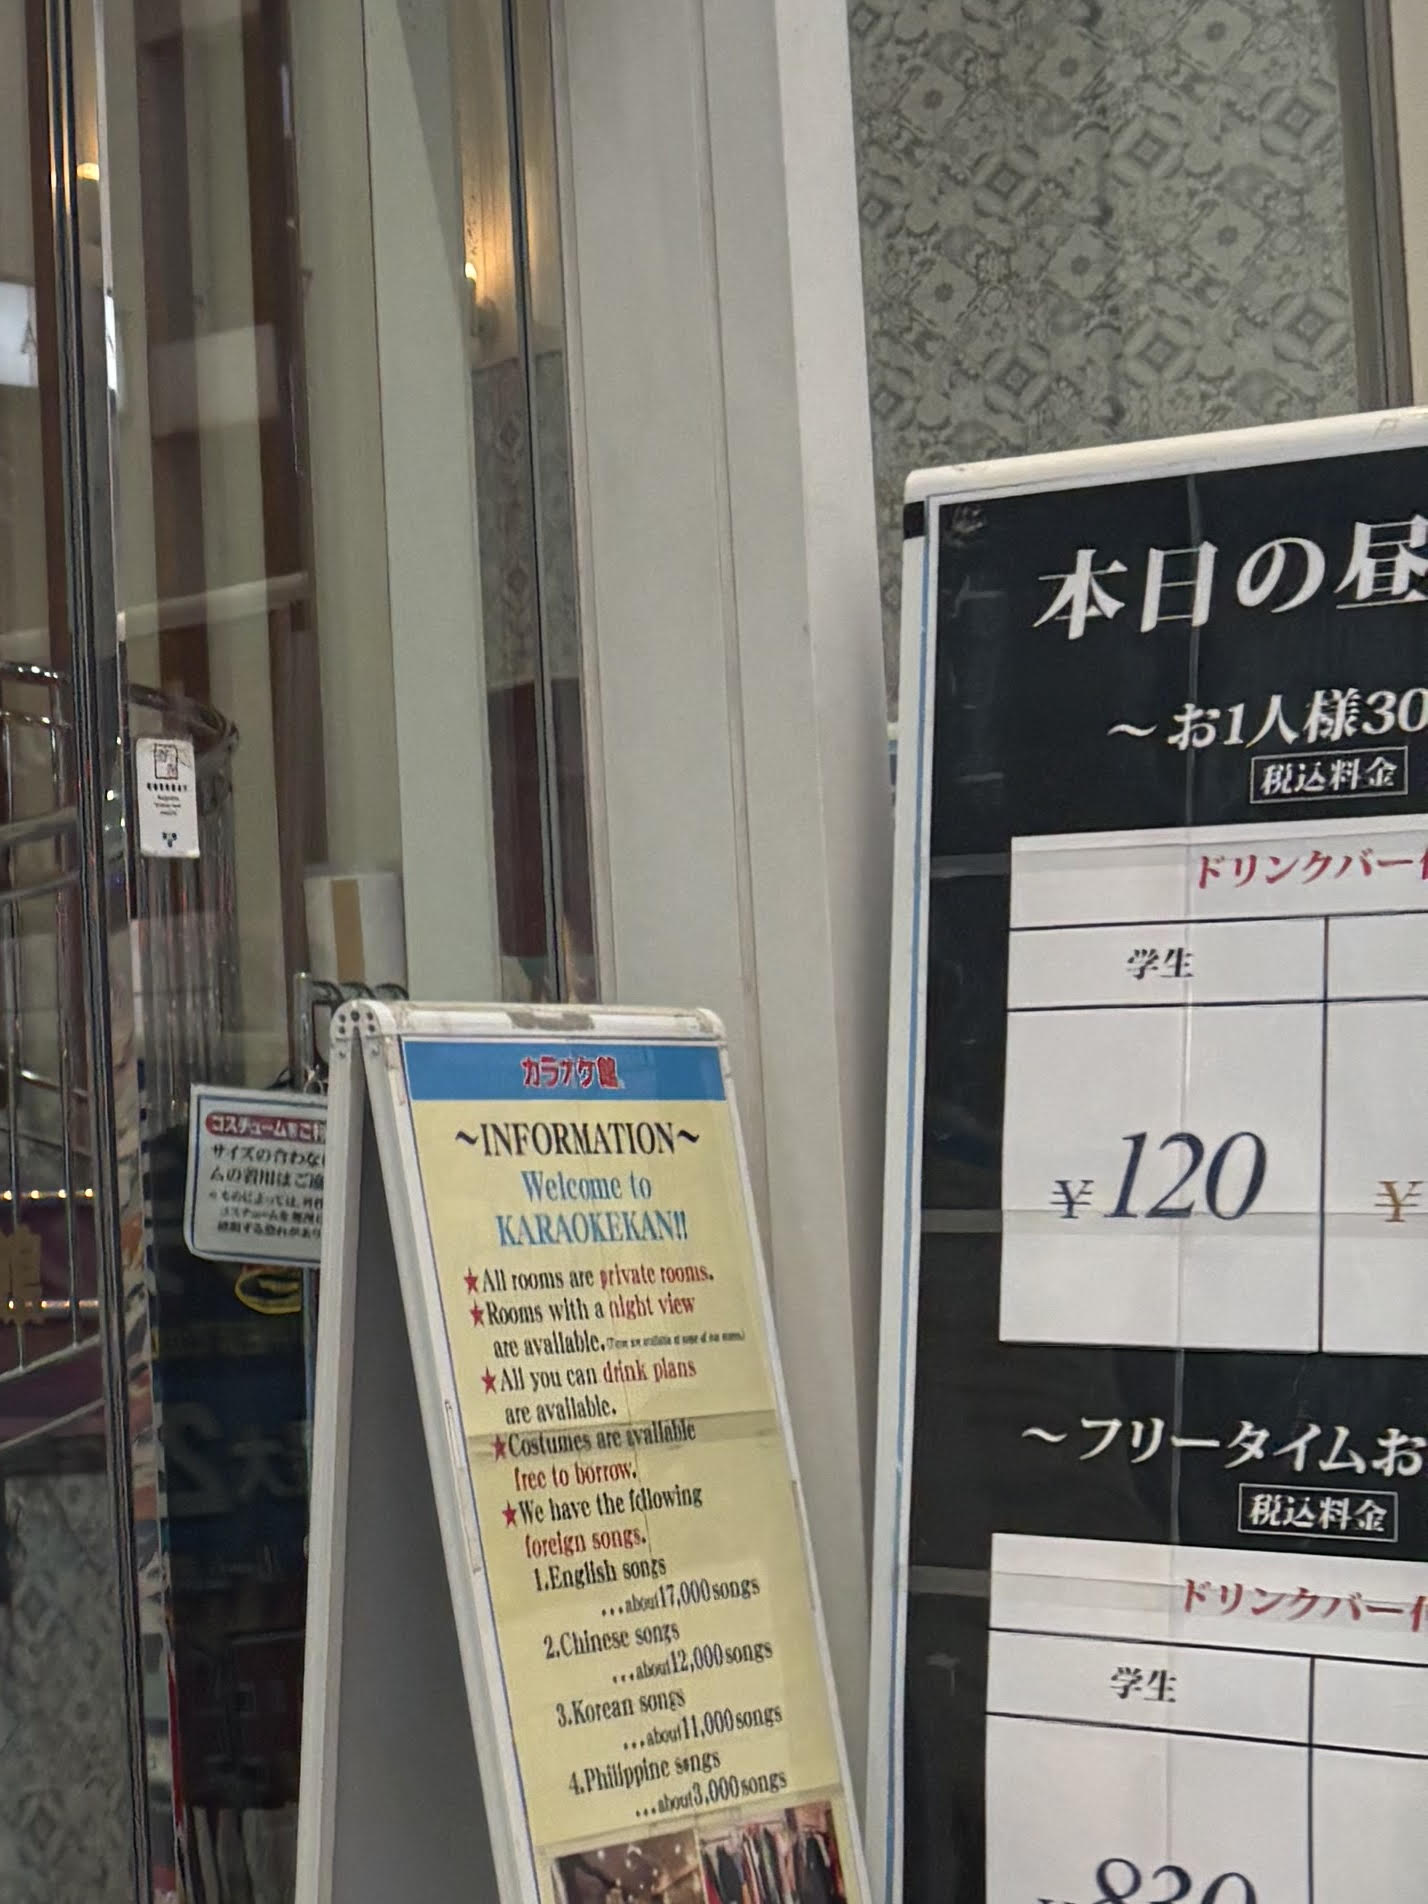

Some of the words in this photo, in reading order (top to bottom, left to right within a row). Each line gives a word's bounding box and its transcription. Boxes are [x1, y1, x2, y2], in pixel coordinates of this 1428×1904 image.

[1260, 754, 1399, 797] 税込料金
[1126, 948, 1195, 983] 学生
[521, 1170, 623, 1202] Welcome
[630, 1170, 652, 1200] to
[1048, 1129, 1268, 1223] ¥120
[496, 1210, 689, 1247] KARAOKEKAN!!
[482, 1268, 507, 1293] All
[512, 1272, 564, 1292] rooms
[569, 1271, 594, 1288] are
[600, 1263, 656, 1291] private
[659, 1262, 714, 1284] rooms.
[485, 1298, 543, 1326] Rooms
[549, 1297, 590, 1321] with
[594, 1300, 605, 1320] a
[609, 1292, 654, 1321] night
[658, 1292, 696, 1317] view
[493, 1340, 519, 1359] are
[524, 1329, 606, 1356] available.
[500, 1367, 525, 1393] All
[530, 1371, 561, 1395] you
[567, 1365, 598, 1386] can
[603, 1359, 648, 1385] drink
[654, 1356, 697, 1383] plans
[505, 1405, 532, 1427] are
[537, 1396, 618, 1425] available.
[508, 1429, 592, 1461] Costumes
[597, 1428, 623, 1451] are
[626, 1415, 697, 1447] available
[514, 1464, 547, 1493] free
[552, 1463, 569, 1489] to
[574, 1458, 638, 1487] borrow.
[517, 1498, 545, 1527] We
[550, 1492, 592, 1524] have
[596, 1490, 625, 1517] the
[629, 1483, 704, 1516] following
[1250, 1494, 1388, 1532] 税込料金
[525, 1530, 587, 1560] foreign
[592, 1523, 647, 1553] songs.
[533, 1557, 618, 1593] 1.English
[622, 1553, 667, 1579] songs
[543, 1625, 630, 1660] 2.Chinese
[634, 1620, 681, 1649] songs
[1109, 1666, 1178, 1704] 学生
[556, 1694, 634, 1729] 3.Korean
[638, 1687, 686, 1716] songs
[568, 1758, 671, 1797] 4.Philippine
[674, 1748, 722, 1777] songs
